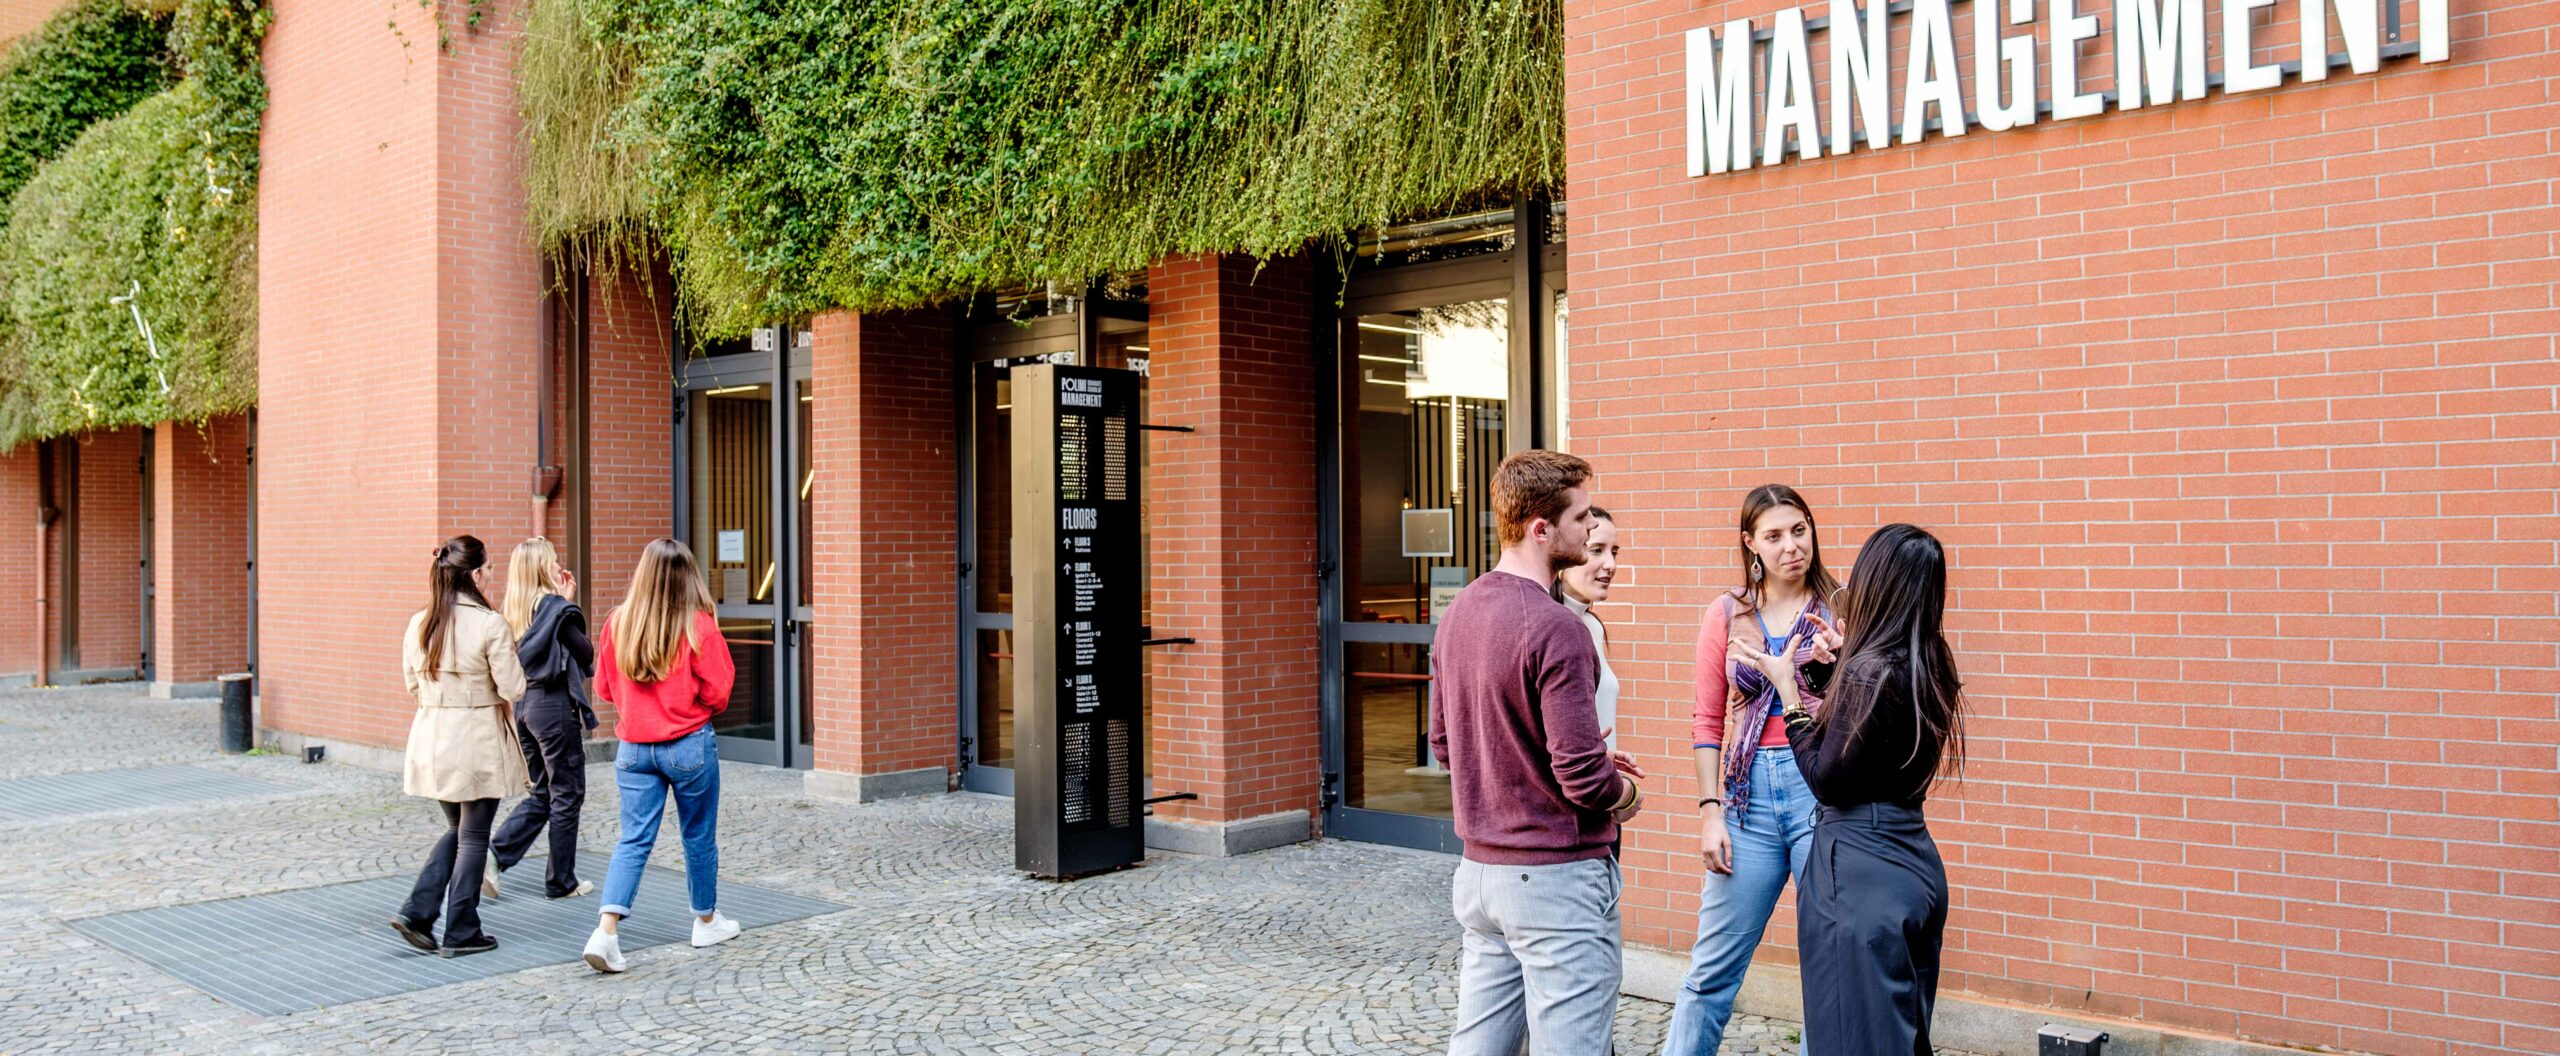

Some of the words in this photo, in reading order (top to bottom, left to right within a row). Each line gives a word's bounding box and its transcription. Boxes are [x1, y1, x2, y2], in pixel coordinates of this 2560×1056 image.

[1061, 377, 1087, 392] POLIMI
[1061, 391, 1102, 407] MANAGEMENT
[1062, 507, 1097, 530] FLOORS
